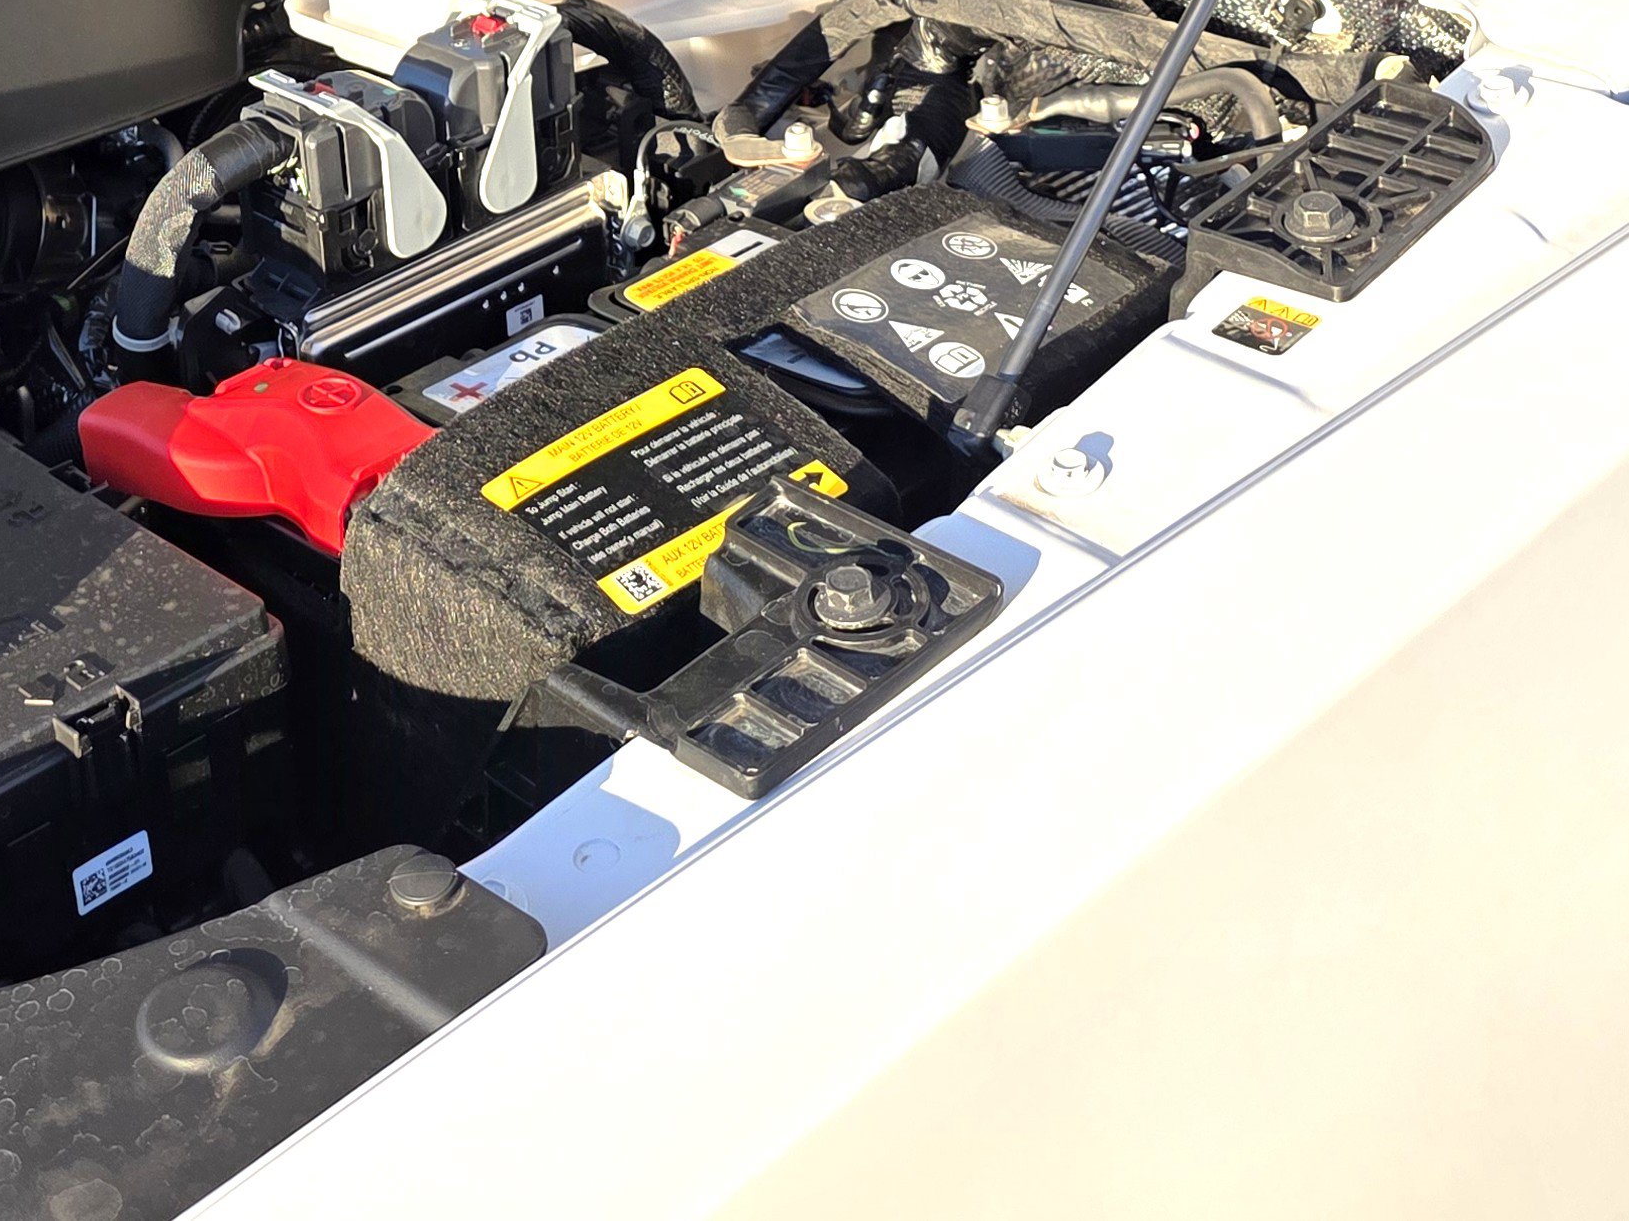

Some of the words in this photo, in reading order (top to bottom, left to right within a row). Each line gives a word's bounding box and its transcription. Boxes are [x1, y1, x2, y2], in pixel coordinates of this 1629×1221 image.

[509, 341, 558, 363] Pb
[548, 441, 576, 457] MAIN
[574, 430, 594, 444] 12V
[592, 408, 636, 434] BATTERY
[569, 437, 611, 462] BATTERIE
[611, 429, 627, 442] DE
[625, 421, 643, 434] 12V
[525, 505, 539, 515] To
[537, 494, 559, 509] Jump
[541, 510, 563, 526] Jump
[559, 500, 582, 514] Main
[578, 485, 608, 504] Battery
[566, 518, 594, 536] vehicle
[604, 504, 618, 515] not
[572, 532, 602, 551] Charge
[598, 522, 620, 536] Both
[616, 506, 651, 527] Batteries
[662, 547, 685, 565] AUX
[684, 537, 703, 550] 12V
